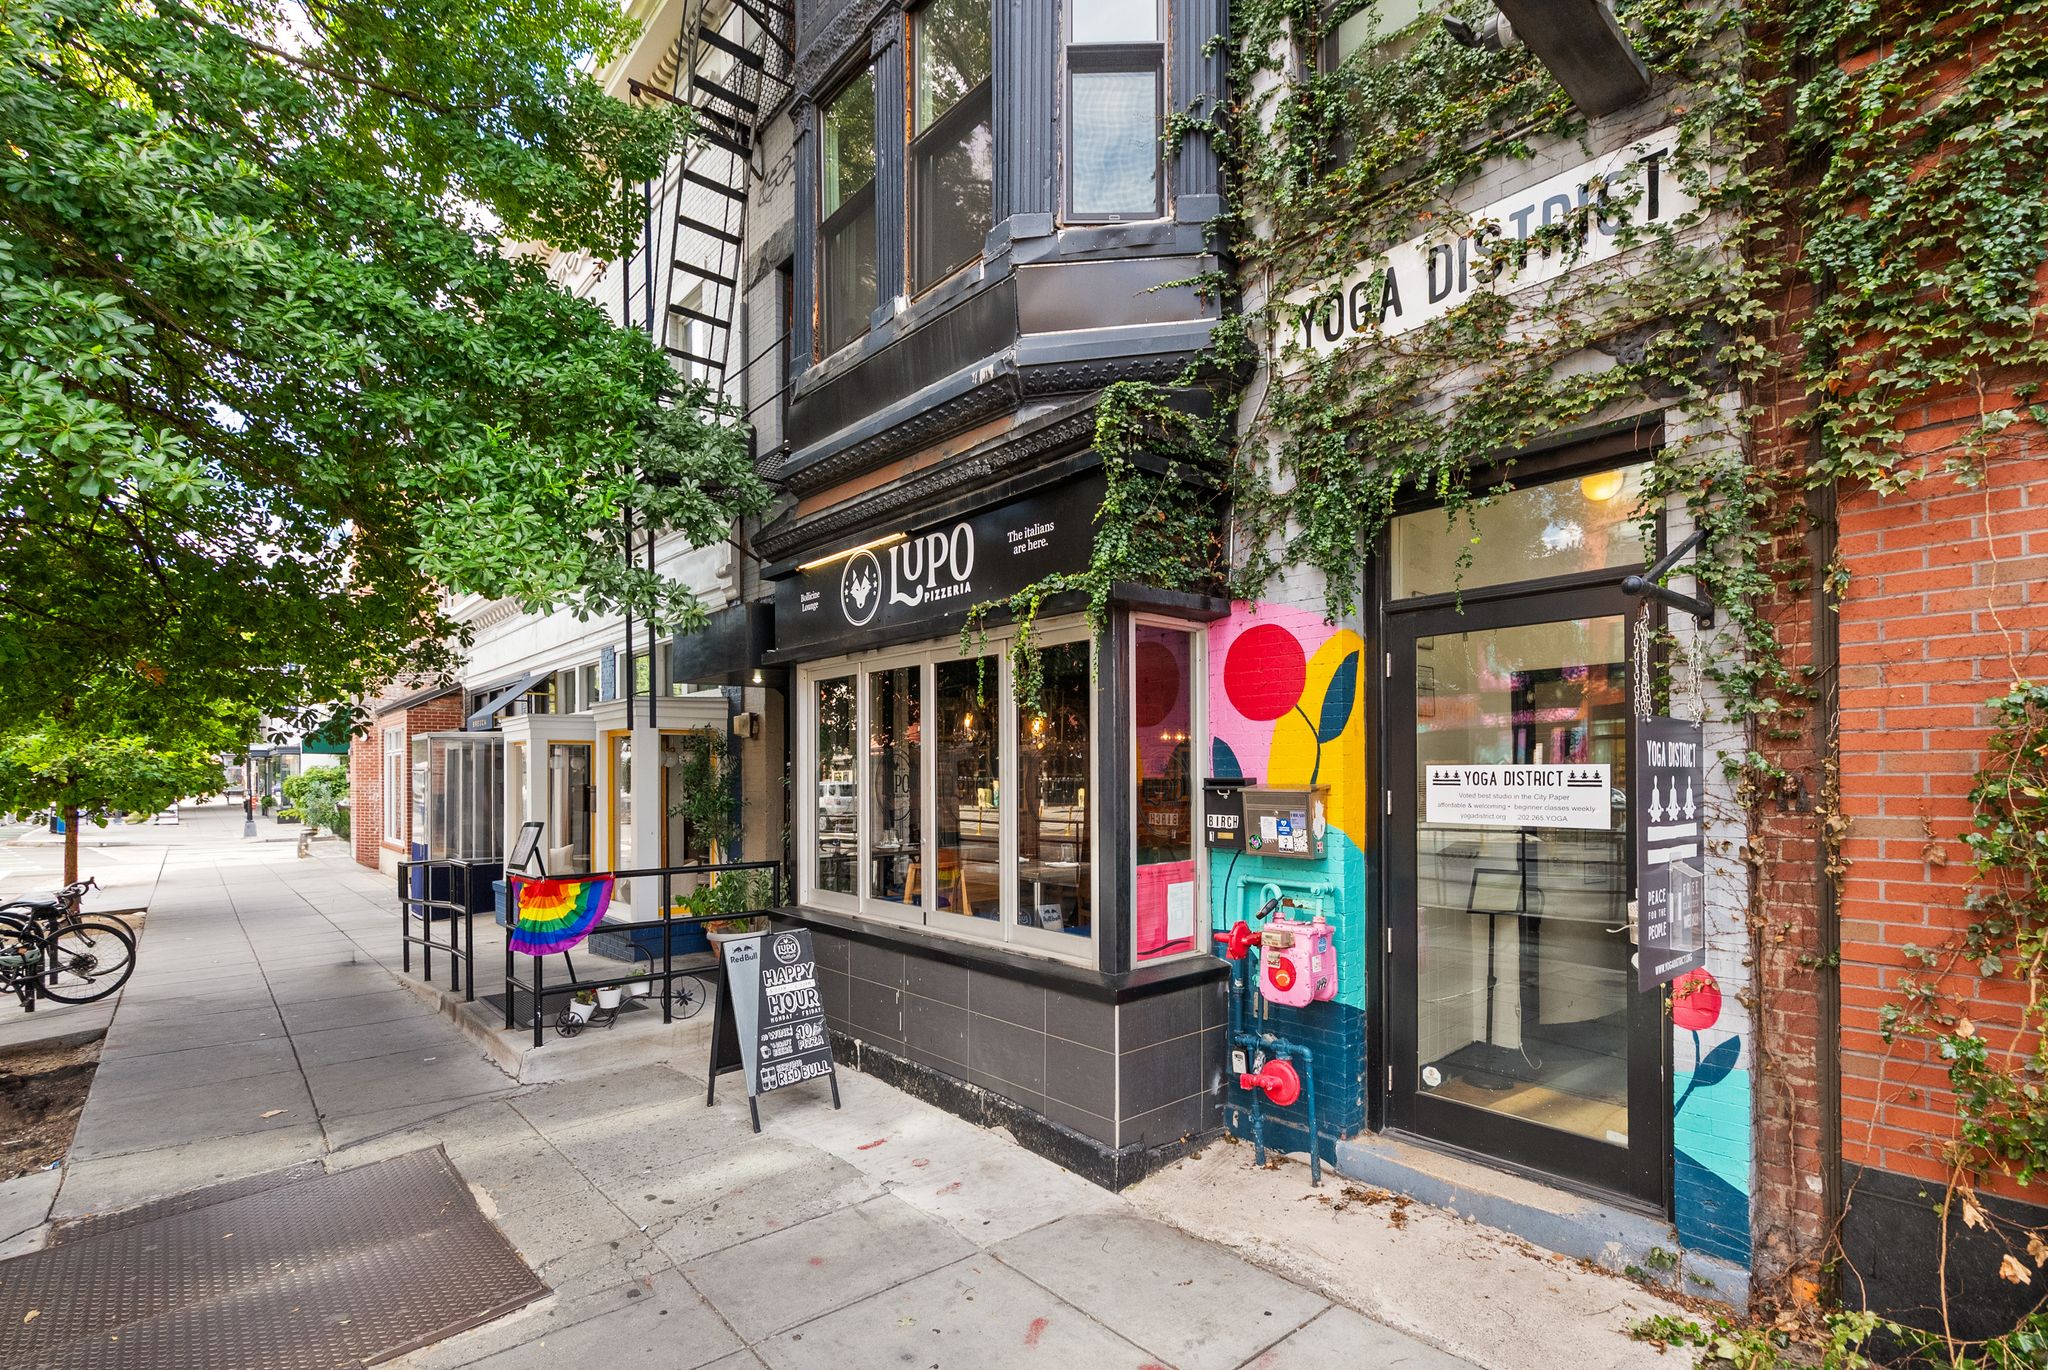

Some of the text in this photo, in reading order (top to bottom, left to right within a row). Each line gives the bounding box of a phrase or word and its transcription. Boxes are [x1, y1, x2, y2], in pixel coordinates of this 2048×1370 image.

[1300, 266, 1403, 348] YOGA
[1007, 521, 1055, 543] The italians
[1013, 538, 1049, 555] are here.
[888, 522, 975, 607] LUPO
[924, 581, 972, 603] PIZZERIA
[1646, 739, 1696, 768] YOGA DISTRICT
[1464, 770, 1563, 787] YOGA DISTRICT
[1533, 793, 1547, 801] City
[1549, 793, 1570, 801] Paper
[1571, 805, 1596, 813] weekly
[1208, 816, 1239, 828] BIRCH
[1647, 888, 1667, 906] PEACE
[1648, 907, 1667, 921] FOR THE
[1648, 921, 1667, 941] PEOPLE
[777, 943, 797, 955] LUPO
[762, 961, 815, 987] HAPPY
[768, 988, 821, 1016] HOUR
[770, 1013, 793, 1024] MONDAY
[801, 1007, 821, 1017] FRIDAY
[797, 1035, 825, 1050] PIZZA
[777, 1060, 832, 1086] RED BULL
